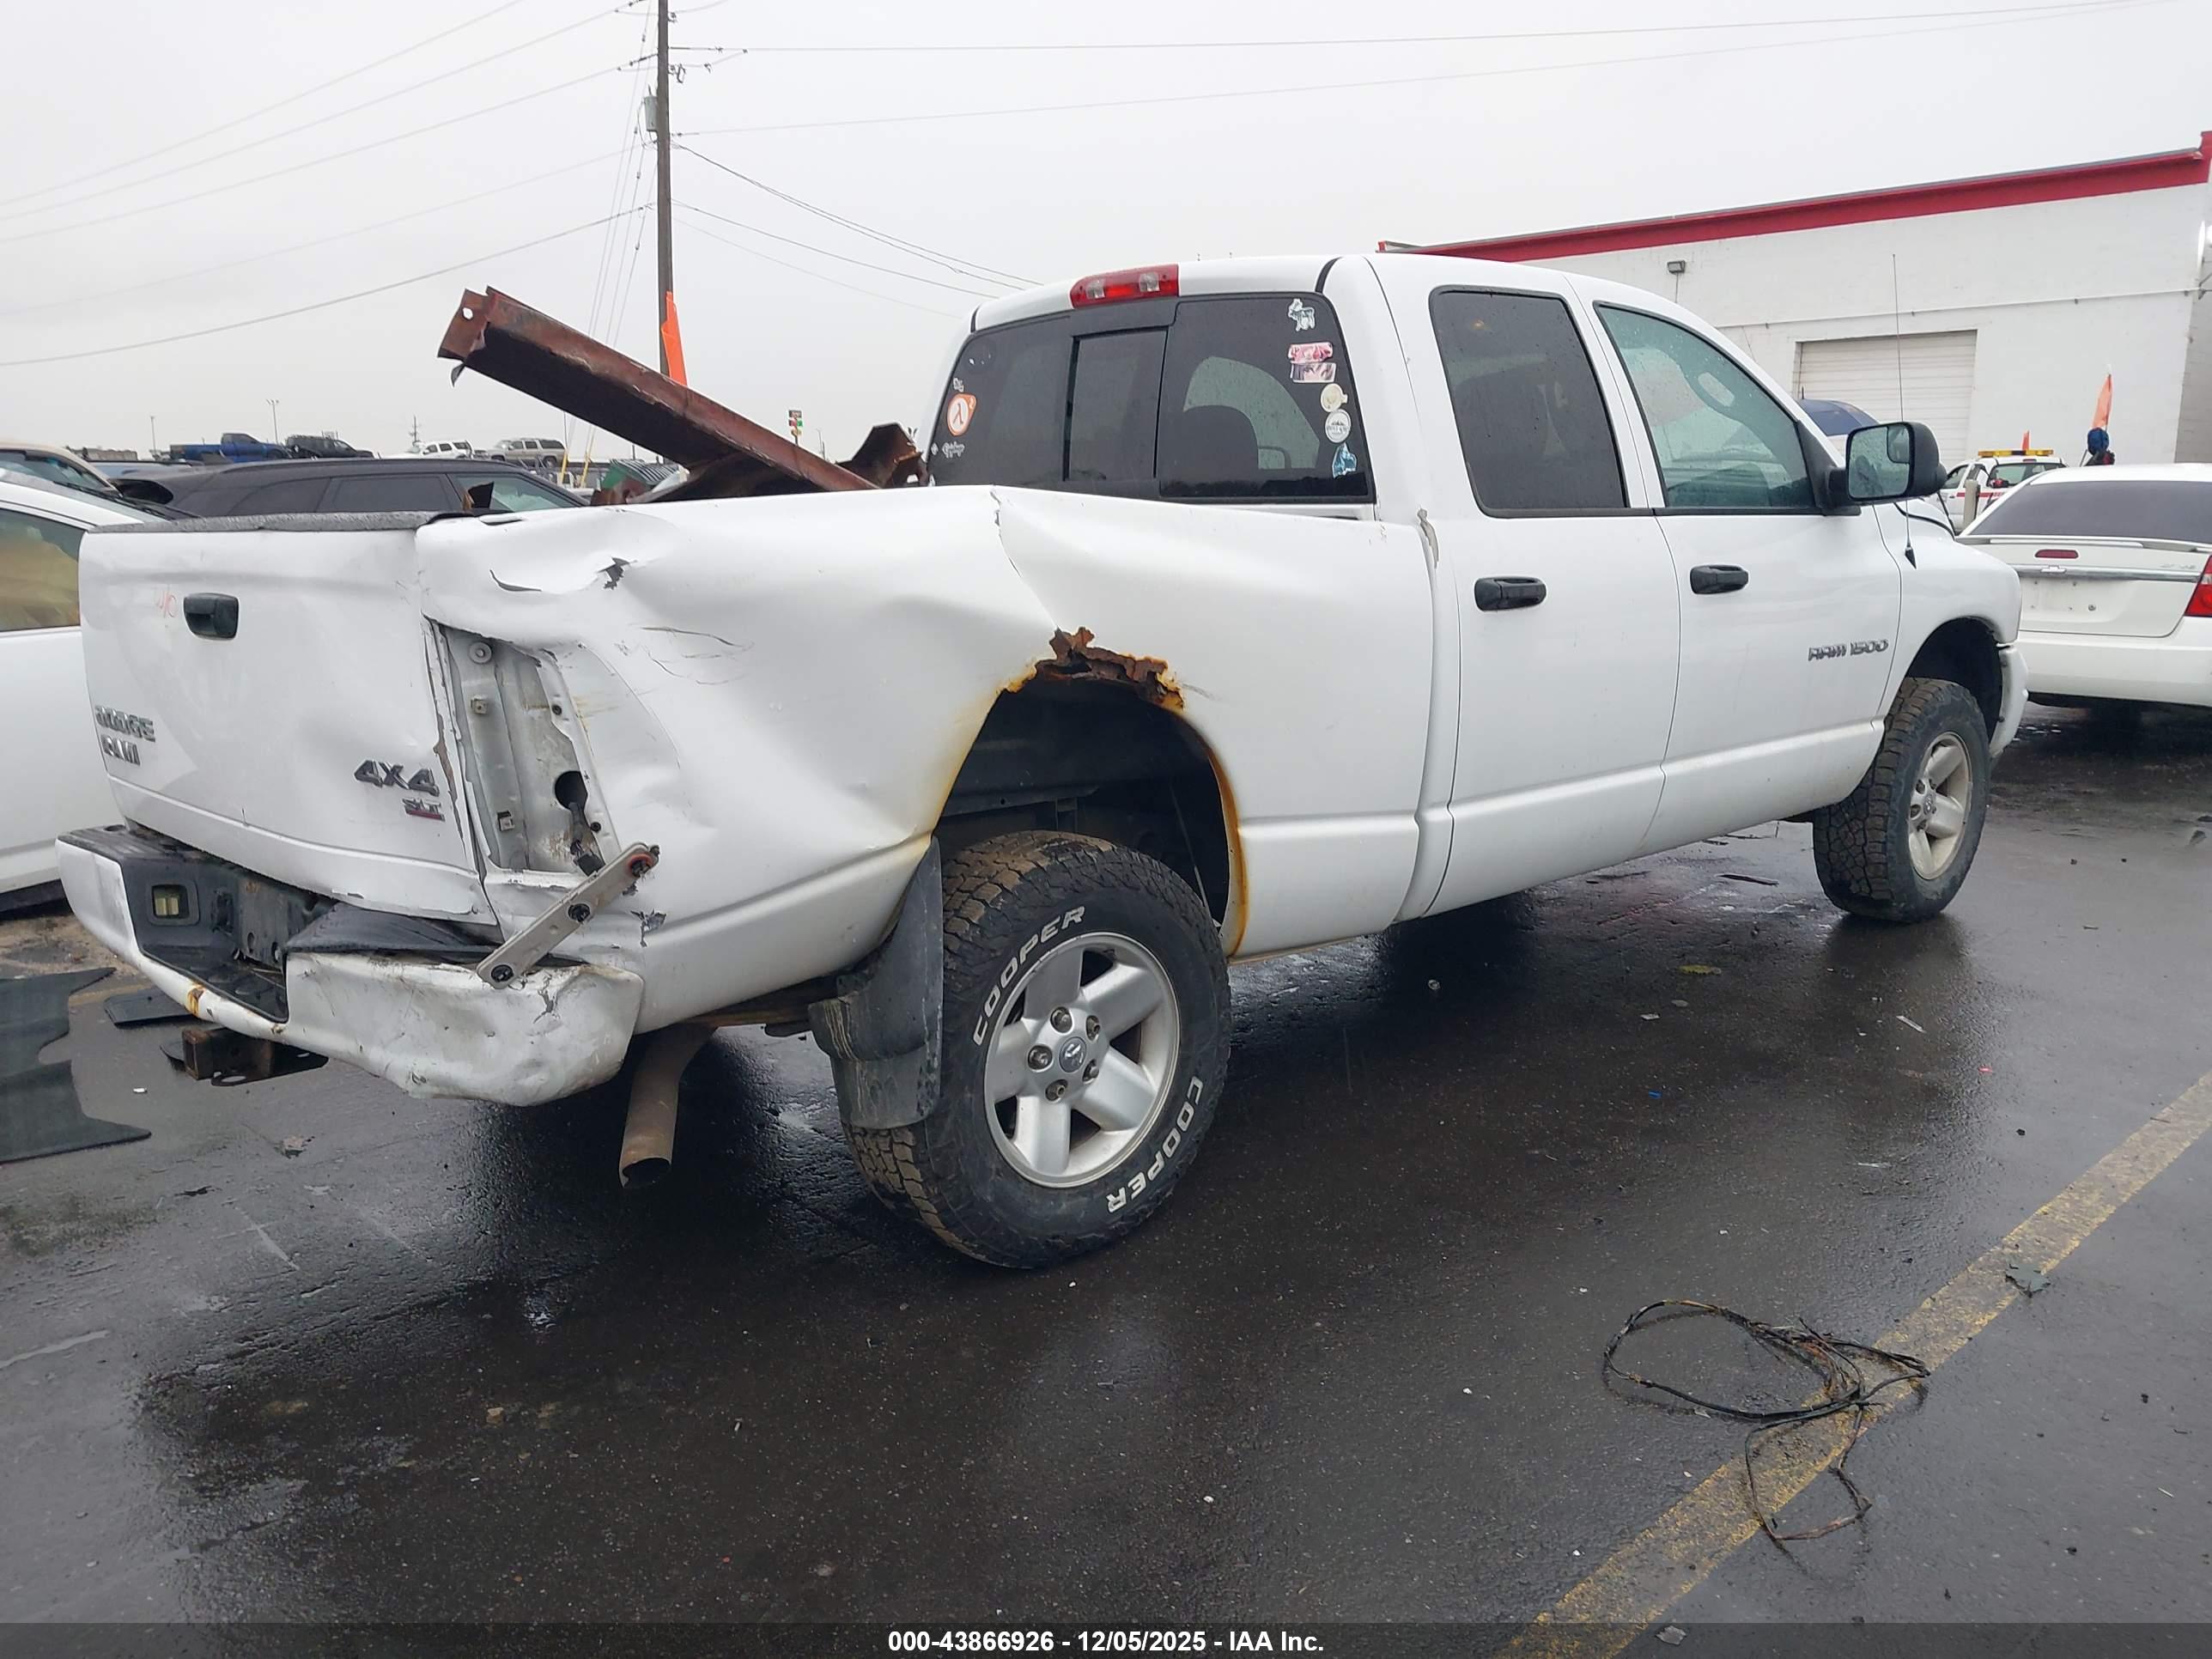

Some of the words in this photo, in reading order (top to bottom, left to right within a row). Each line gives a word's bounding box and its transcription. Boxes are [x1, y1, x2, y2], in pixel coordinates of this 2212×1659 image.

[1808, 645, 1847, 661] RAM
[1850, 640, 1888, 656] 1500
[402, 799, 445, 821] SLT
[972, 905, 1085, 1047] COOPER
[1105, 1076, 1204, 1214] COOPER
